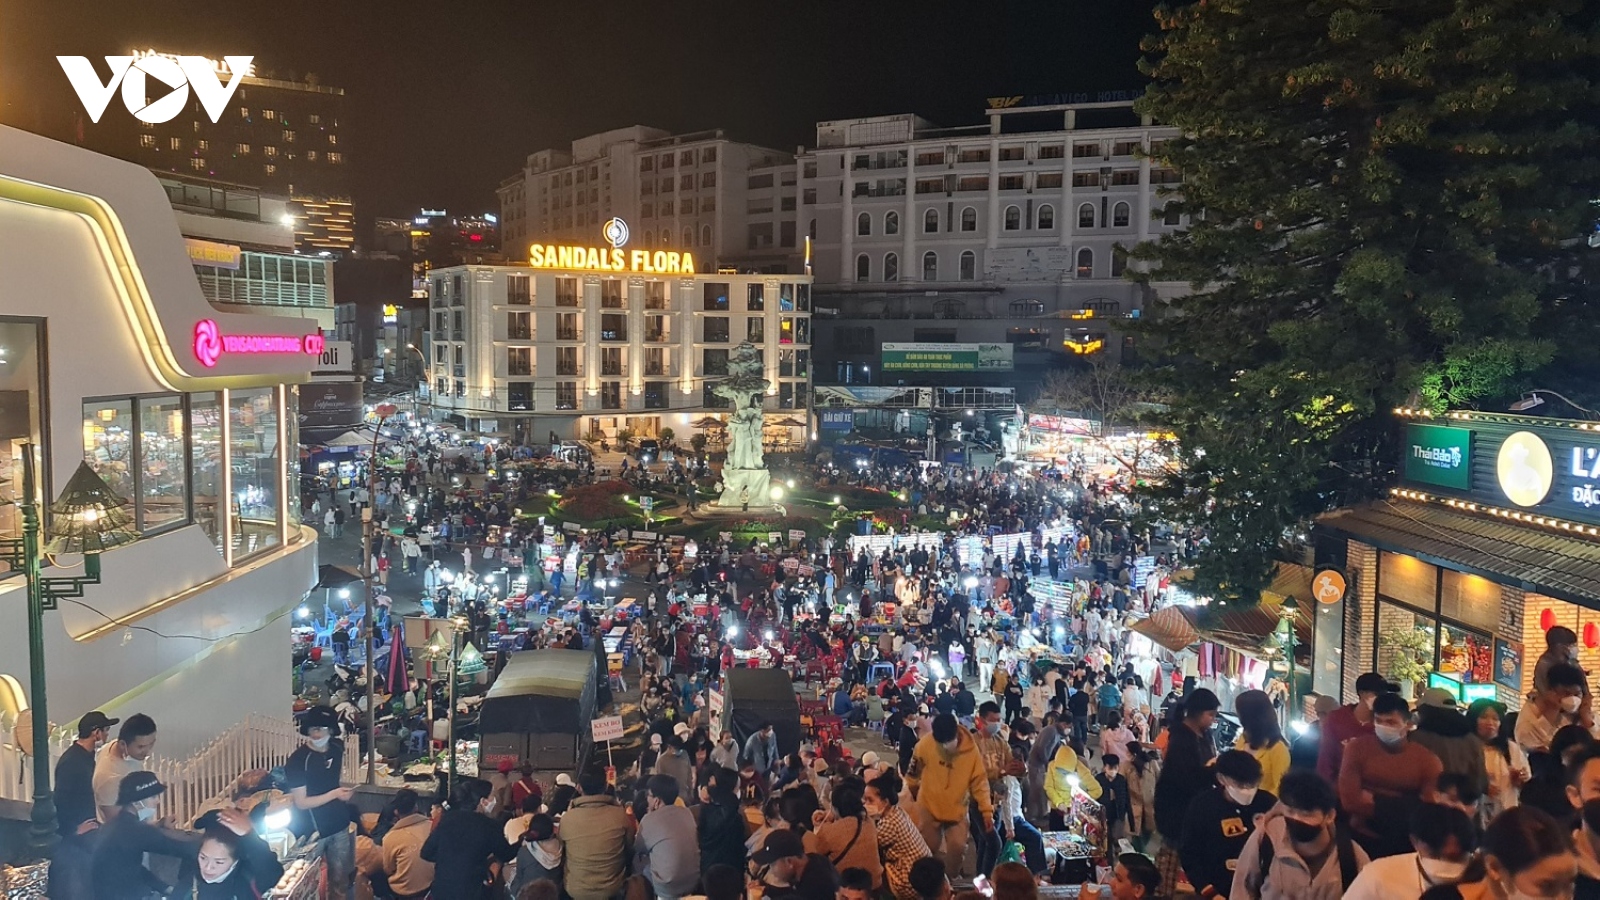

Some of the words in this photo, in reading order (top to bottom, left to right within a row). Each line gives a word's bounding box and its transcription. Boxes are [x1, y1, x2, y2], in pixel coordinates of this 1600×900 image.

[1097, 90, 1128, 101] HOTEL
[530, 244, 625, 270] SANDALS
[631, 250, 694, 273] FLORA
[844, 413, 851, 422] XE
[594, 721, 609, 729] KEM
